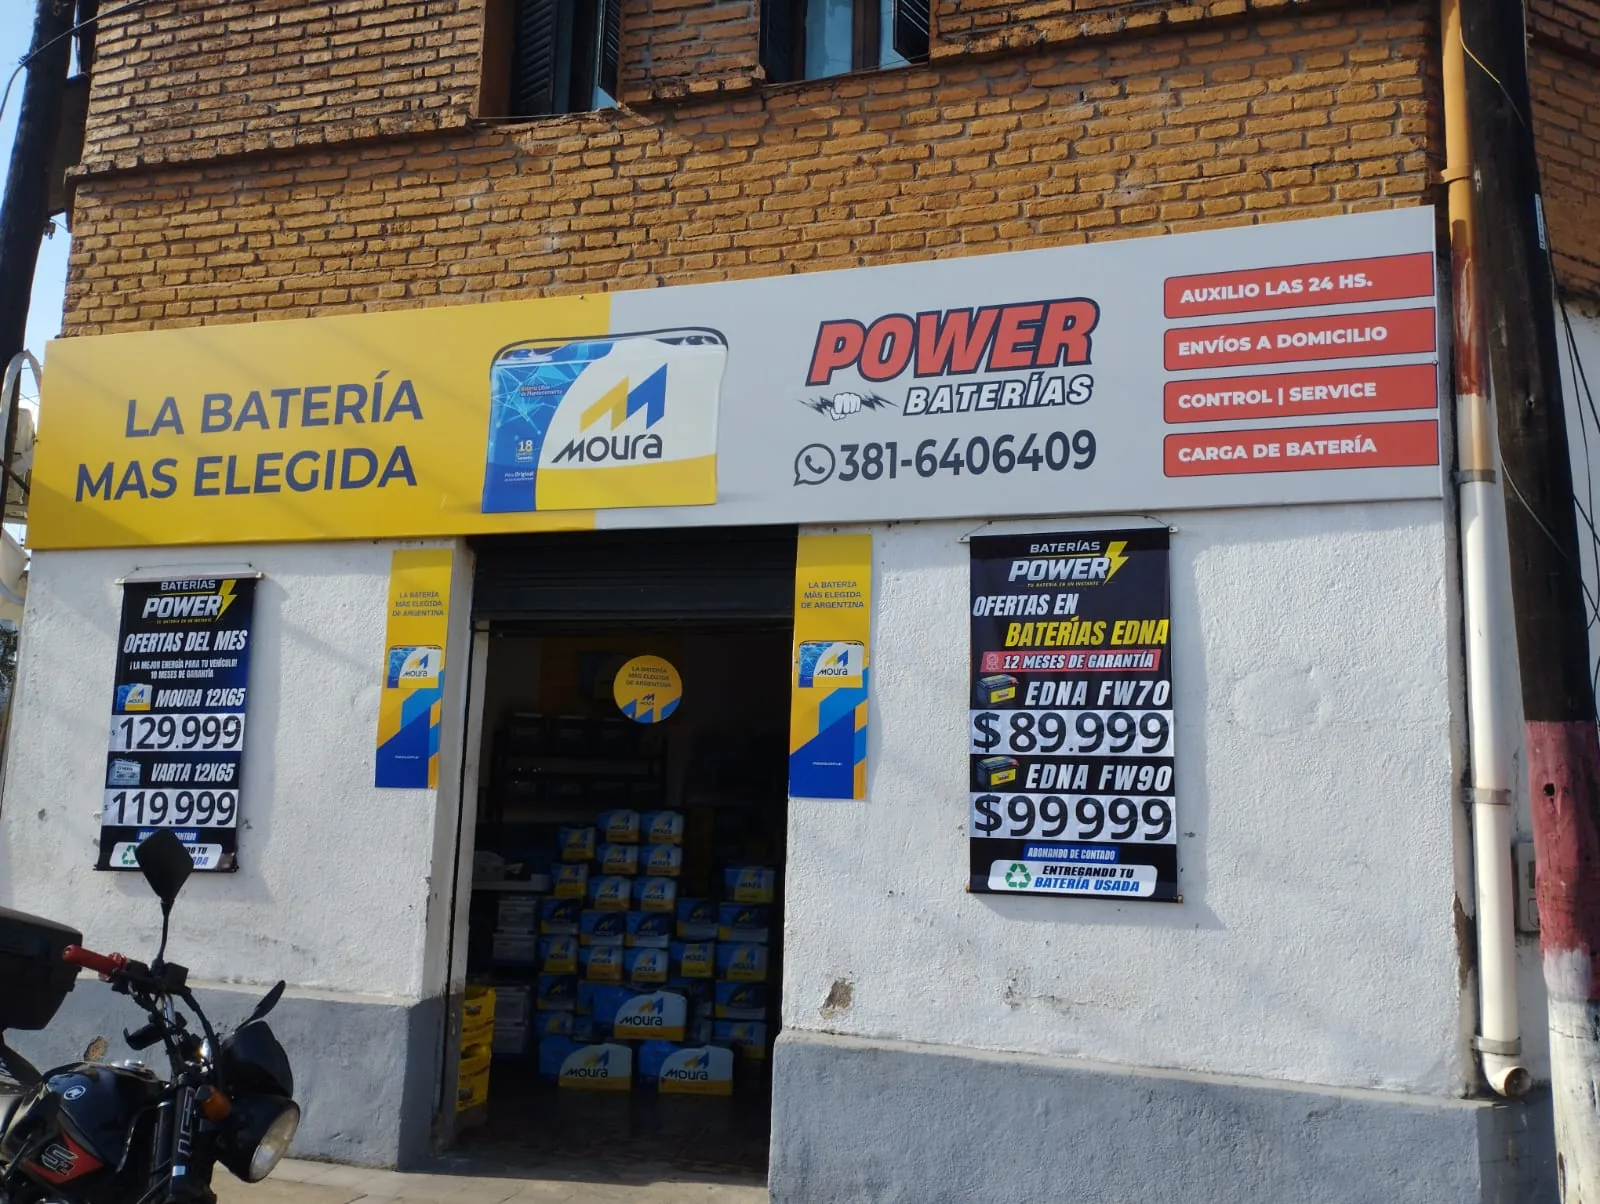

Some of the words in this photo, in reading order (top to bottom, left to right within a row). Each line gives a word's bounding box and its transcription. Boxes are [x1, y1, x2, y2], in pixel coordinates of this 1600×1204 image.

[1180, 283, 1260, 303] AUXILIO
[1265, 279, 1303, 296] LAS
[1308, 276, 1334, 292] 24
[1339, 273, 1373, 289] HS.
[805, 297, 1100, 386] POWER
[1178, 335, 1251, 356] ENVÍOS
[1256, 336, 1272, 350] A
[1276, 326, 1388, 349] DOMICILIO
[126, 397, 184, 438] LA
[200, 370, 424, 434] BATERÍA
[903, 372, 1094, 416] BATERÍAS
[1178, 388, 1273, 408] CONTROL
[1289, 382, 1377, 401] SERVICE
[517, 440, 533, 453] 18
[838, 429, 1096, 481] 381-6406409
[1178, 443, 1248, 462] CARGA
[1253, 443, 1280, 458] DE
[1285, 435, 1377, 457] BATERÍA
[75, 458, 178, 502] MAS
[194, 445, 417, 497] ELEGIDA
[1030, 540, 1100, 553] BATERÍAS
[1008, 557, 1111, 582] POWER
[161, 579, 215, 591] BATERÍAS
[142, 595, 223, 618] POWER
[972, 594, 1050, 617] OFERTAS
[1053, 593, 1079, 615] EN
[124, 632, 184, 653] OFERTAS
[184, 631, 211, 651] DEL
[213, 630, 248, 651] MES
[1005, 615, 1106, 647] BATERÍAS
[1111, 619, 1169, 646] EDNA
[1003, 655, 1020, 669] 12
[1022, 655, 1065, 669] MESES
[1068, 654, 1085, 668] DE
[1087, 651, 1154, 668] GARANTÍA
[155, 689, 202, 708] MOURA
[205, 687, 246, 707] 12X65
[1025, 681, 1088, 706] EDNA
[1097, 680, 1170, 706] FW70
[150, 763, 192, 782] VARTA
[194, 763, 235, 782] 12X65
[1025, 763, 1089, 790] EDNA
[1099, 765, 1173, 792] FW90
[1027, 848, 1068, 859] ABONANDO
[1070, 849, 1079, 859] DE
[1081, 850, 1115, 860] CONTADO
[1034, 875, 1090, 890] BATERÍA
[1094, 879, 1140, 892] USADA
[1042, 865, 1116, 877] ENTREGANDO
[1120, 868, 1134, 879] TU
